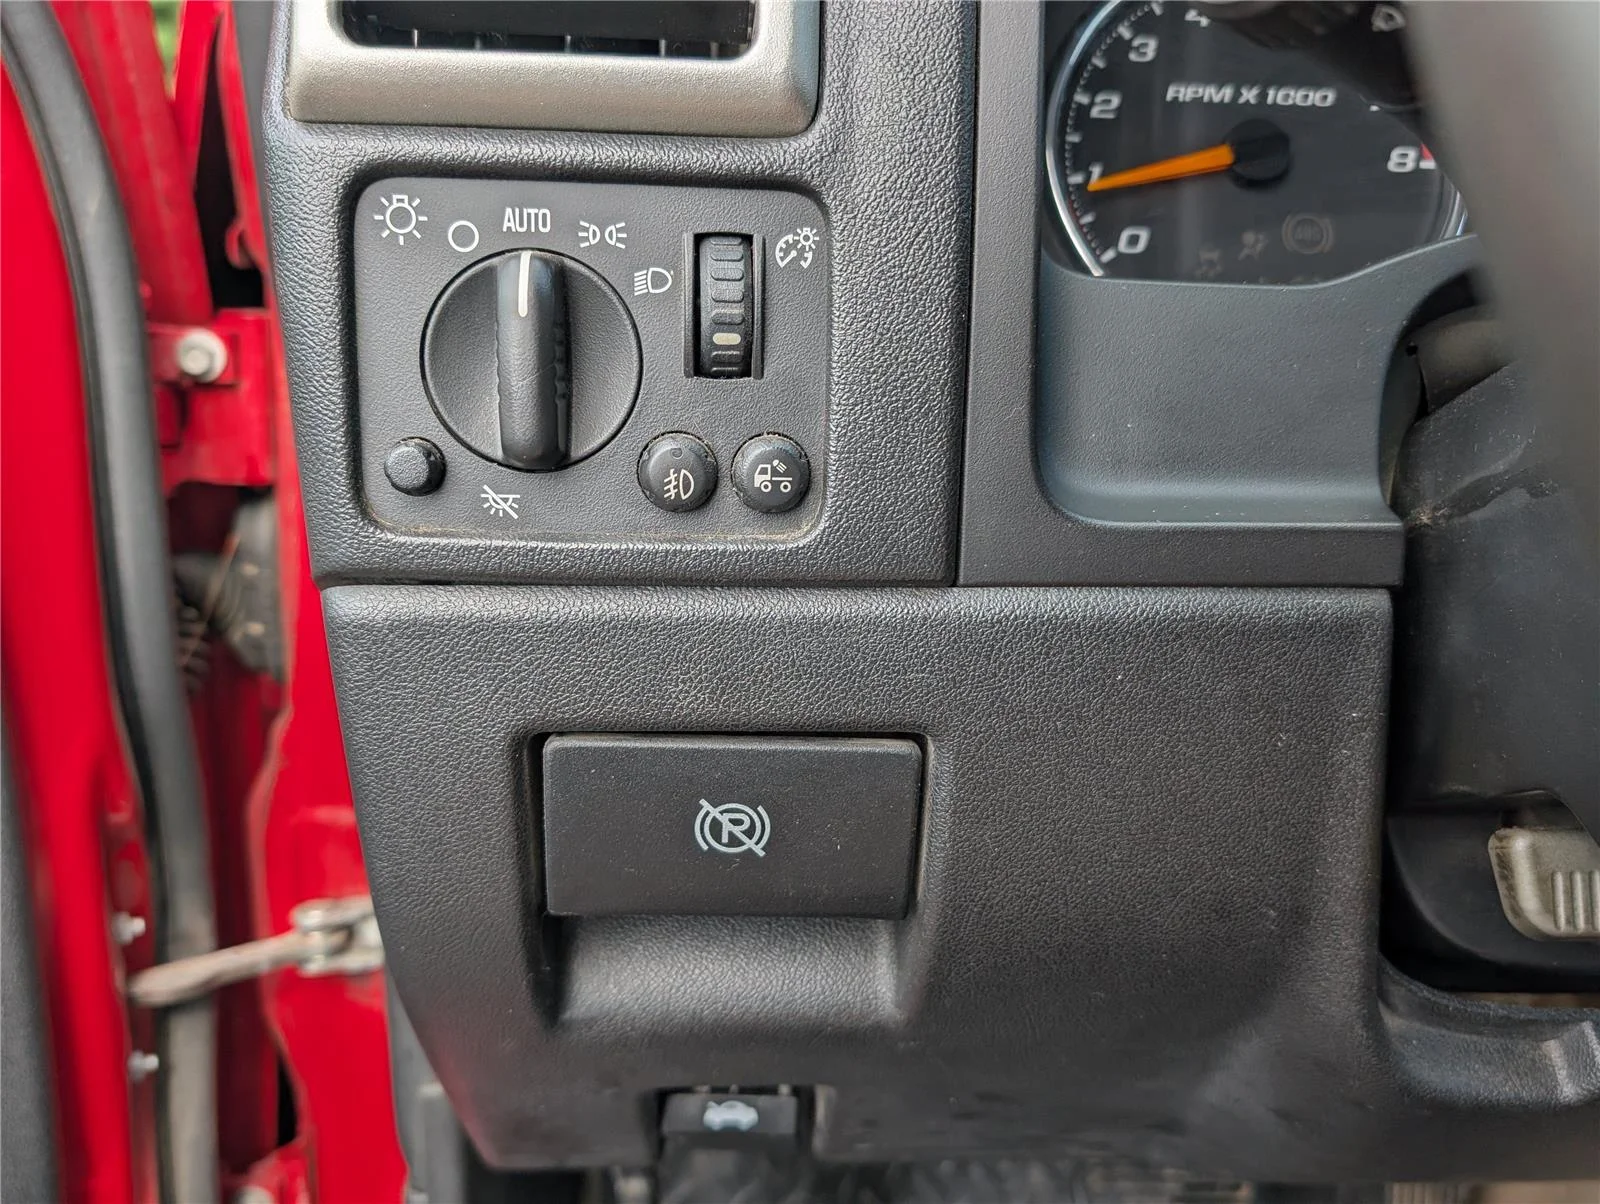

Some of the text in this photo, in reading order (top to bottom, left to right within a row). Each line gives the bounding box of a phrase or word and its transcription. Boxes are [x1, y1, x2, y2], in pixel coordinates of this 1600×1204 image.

[1128, 33, 1159, 63] 3
[1089, 90, 1123, 119] 2
[1165, 82, 1337, 108] RPM X 1000
[1386, 146, 1419, 173] 8
[502, 206, 551, 233] AUTO
[1117, 225, 1151, 254] 0
